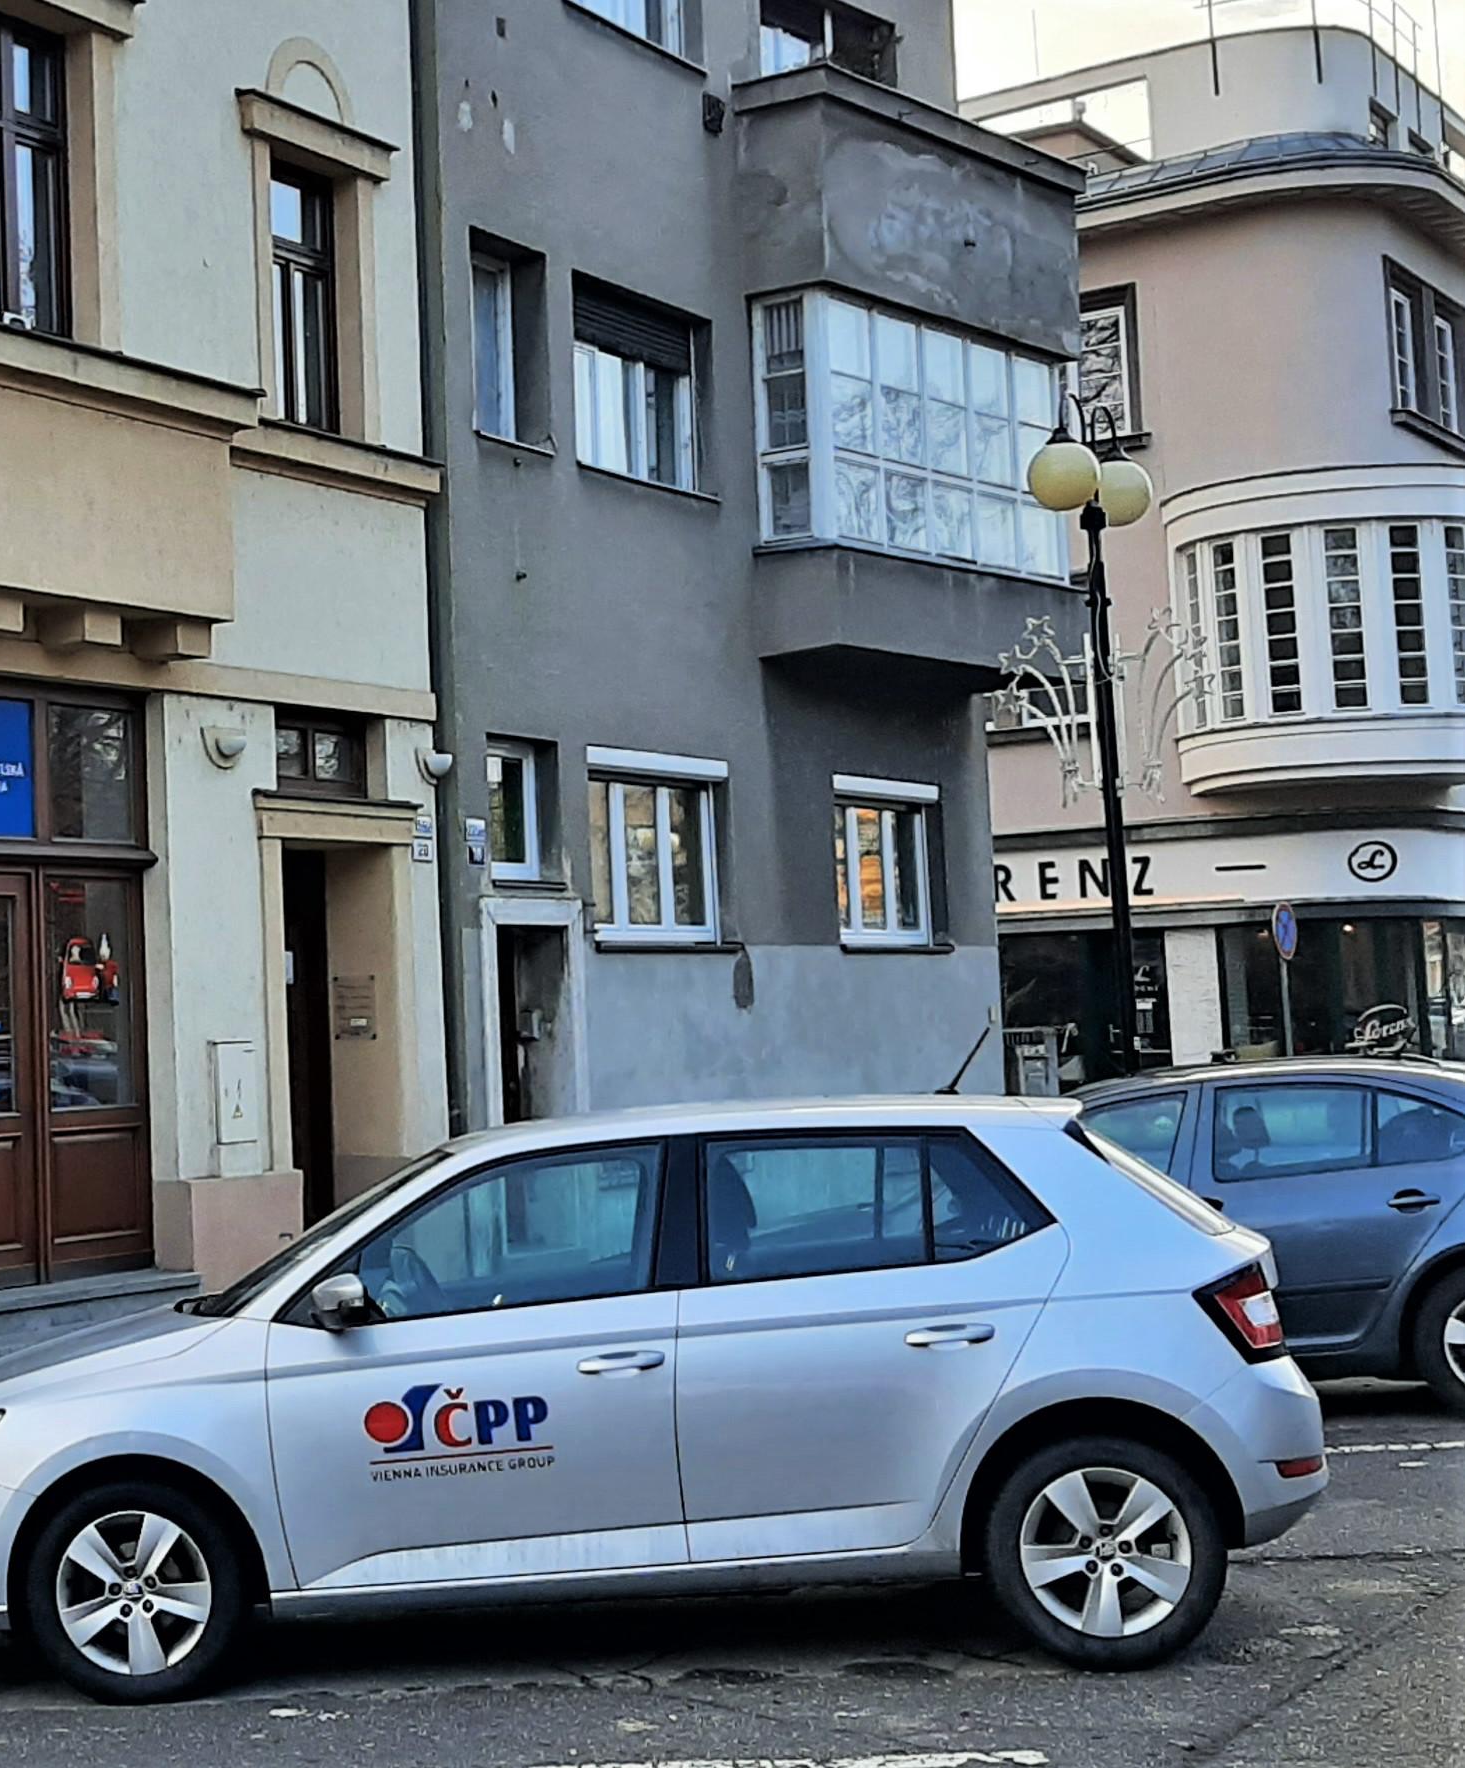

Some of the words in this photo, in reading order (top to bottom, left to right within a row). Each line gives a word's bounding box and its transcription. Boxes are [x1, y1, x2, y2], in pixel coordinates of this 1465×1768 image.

[993, 855, 1154, 903] RENZ
[434, 1387, 549, 1448] ČPP
[370, 1465, 423, 1483] VIENNA
[426, 1459, 505, 1479] INSURANCE
[508, 1454, 556, 1471] GROUP
